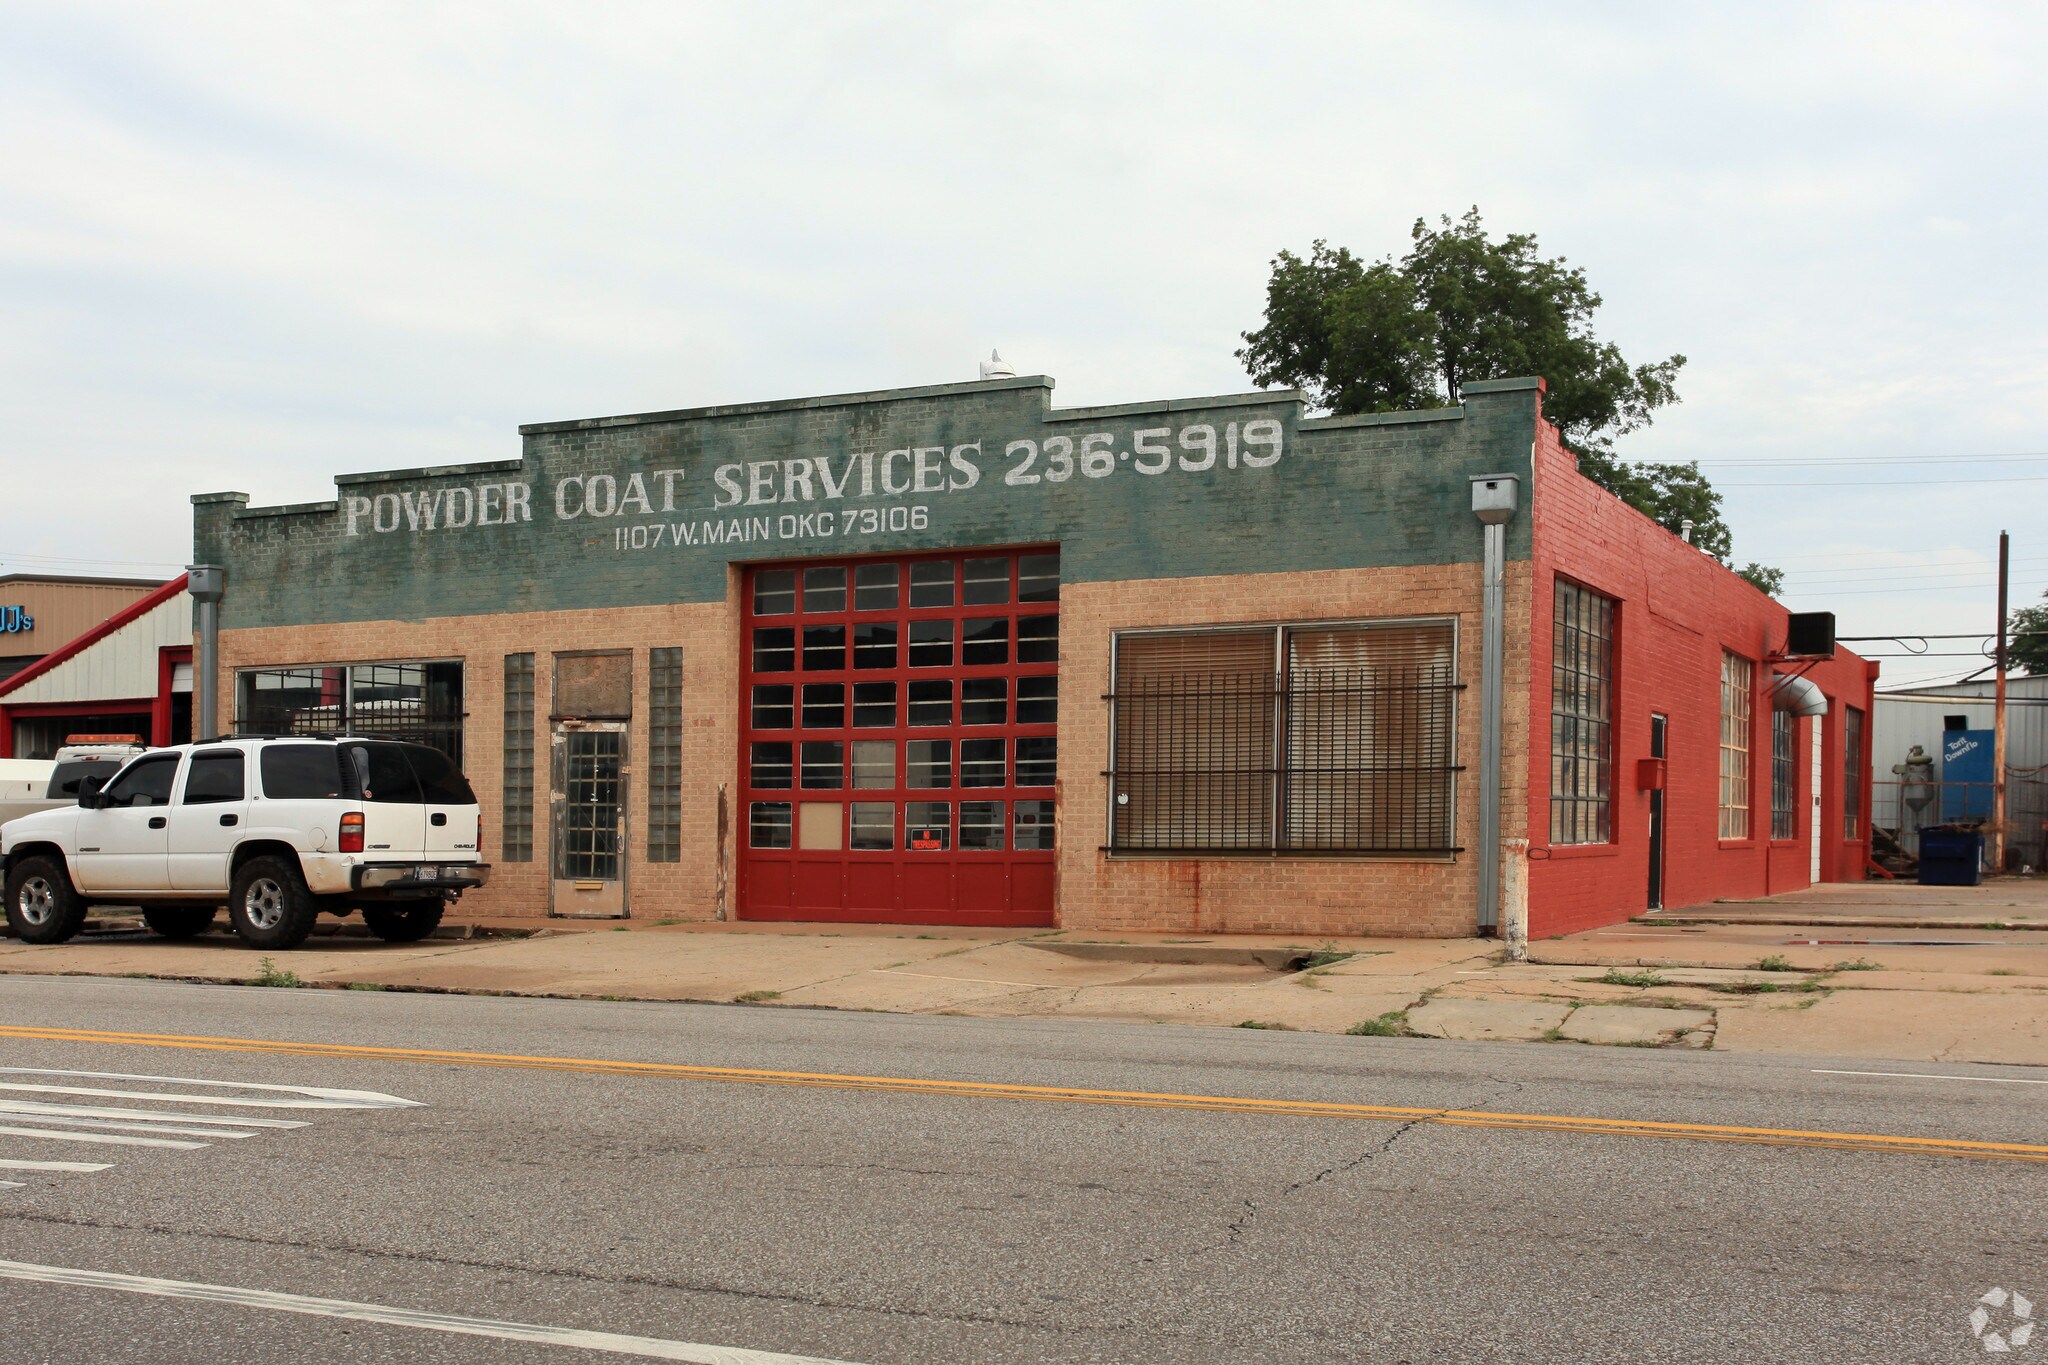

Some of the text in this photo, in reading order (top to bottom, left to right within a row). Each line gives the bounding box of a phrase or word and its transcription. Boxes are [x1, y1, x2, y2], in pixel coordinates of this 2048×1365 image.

[344, 482, 533, 536] POWDER
[556, 469, 685, 520] COAT
[713, 438, 982, 511] SERVICES
[615, 523, 664, 550] 1107
[779, 513, 833, 539] OKC
[842, 505, 929, 536] 73106
[1945, 741, 1978, 762] Downflo
[1947, 736, 1967, 750] Torit
